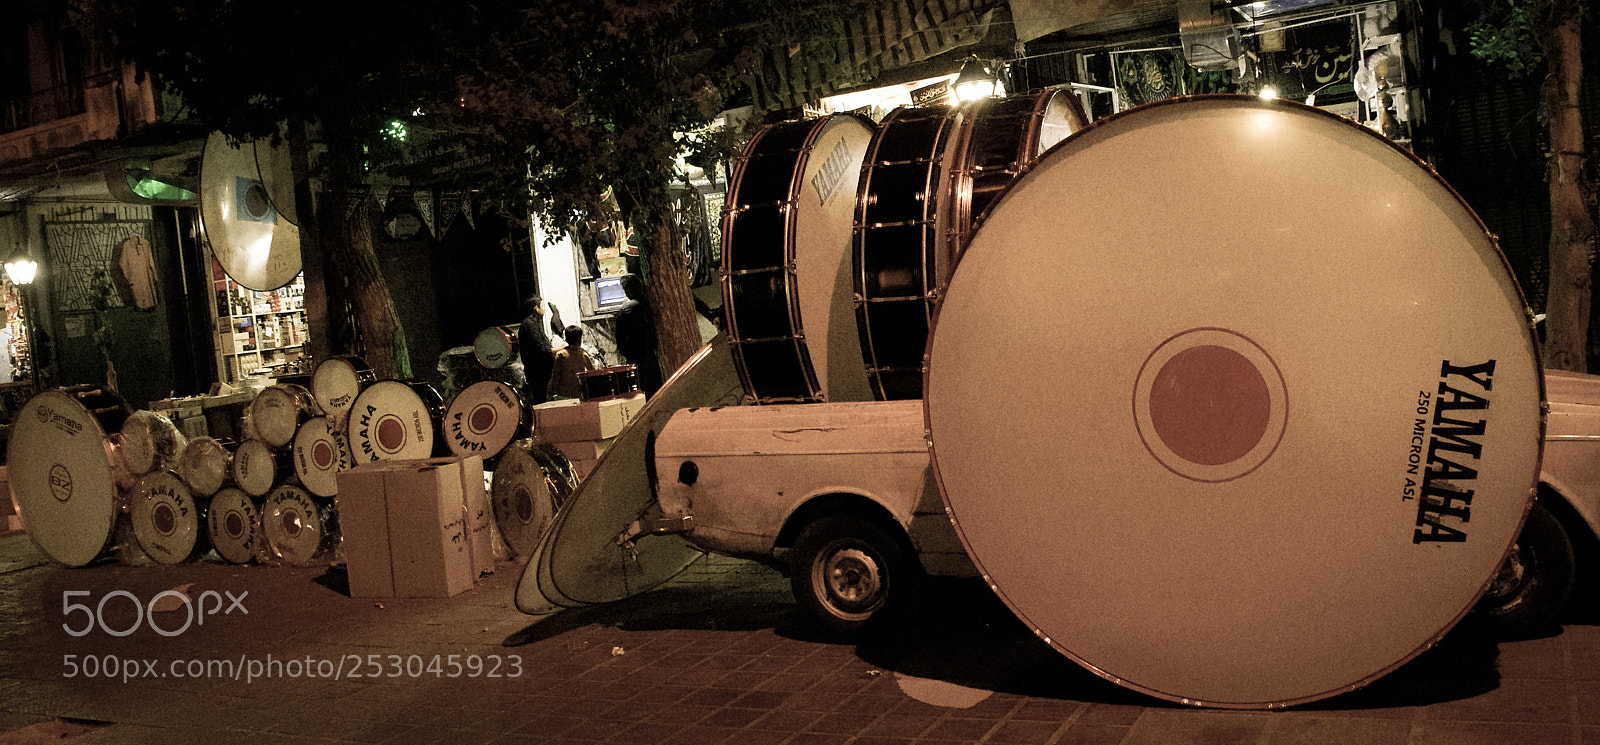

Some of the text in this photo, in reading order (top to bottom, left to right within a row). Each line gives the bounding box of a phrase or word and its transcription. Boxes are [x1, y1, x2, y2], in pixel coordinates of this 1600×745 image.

[811, 136, 853, 207] YAMAHA
[47, 408, 82, 431] Yamaha
[360, 404, 380, 462] AMAHA
[452, 412, 487, 451] YAMAHA
[1402, 390, 1431, 502] 250 MICRON ASL
[1413, 360, 1496, 544] YAMAHA
